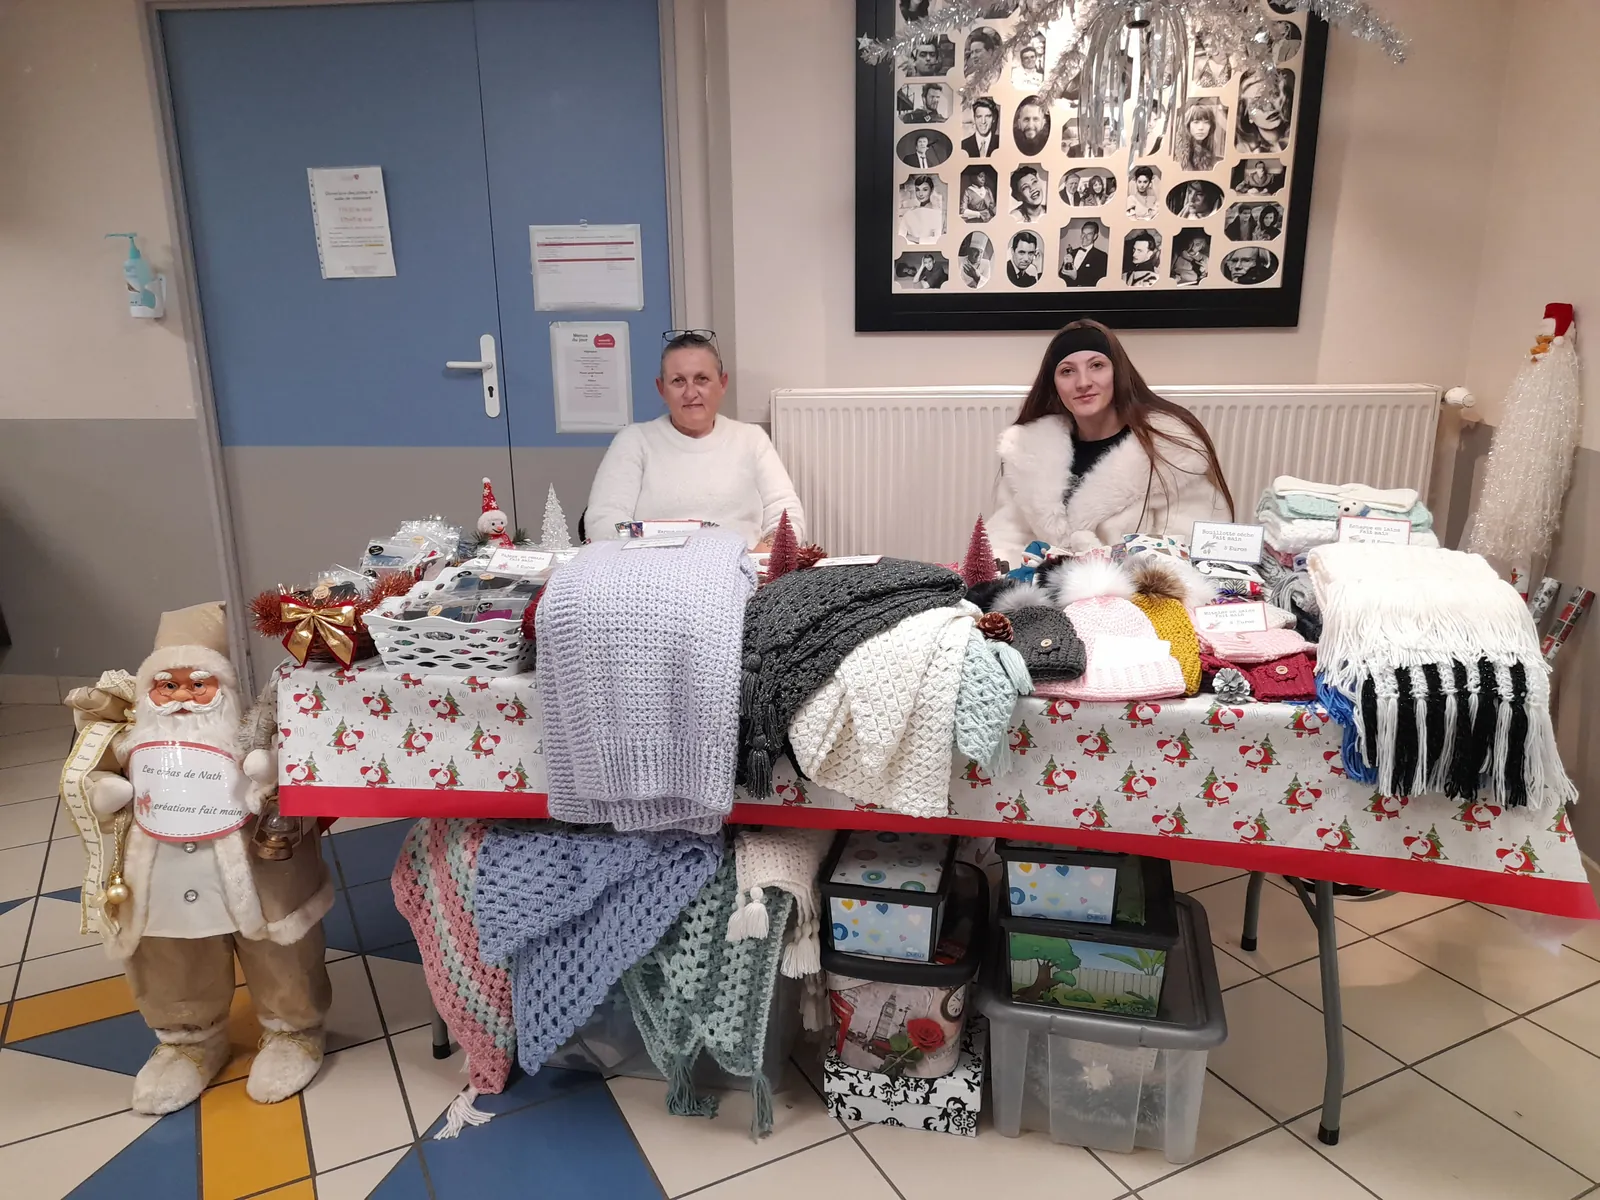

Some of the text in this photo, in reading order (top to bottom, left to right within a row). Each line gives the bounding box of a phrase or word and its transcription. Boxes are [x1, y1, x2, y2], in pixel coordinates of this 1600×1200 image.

[142, 764, 155, 774] Les
[184, 769, 196, 780] de
[198, 770, 222, 781] Nath
[198, 805, 218, 815] fait
[219, 808, 242, 817] main
